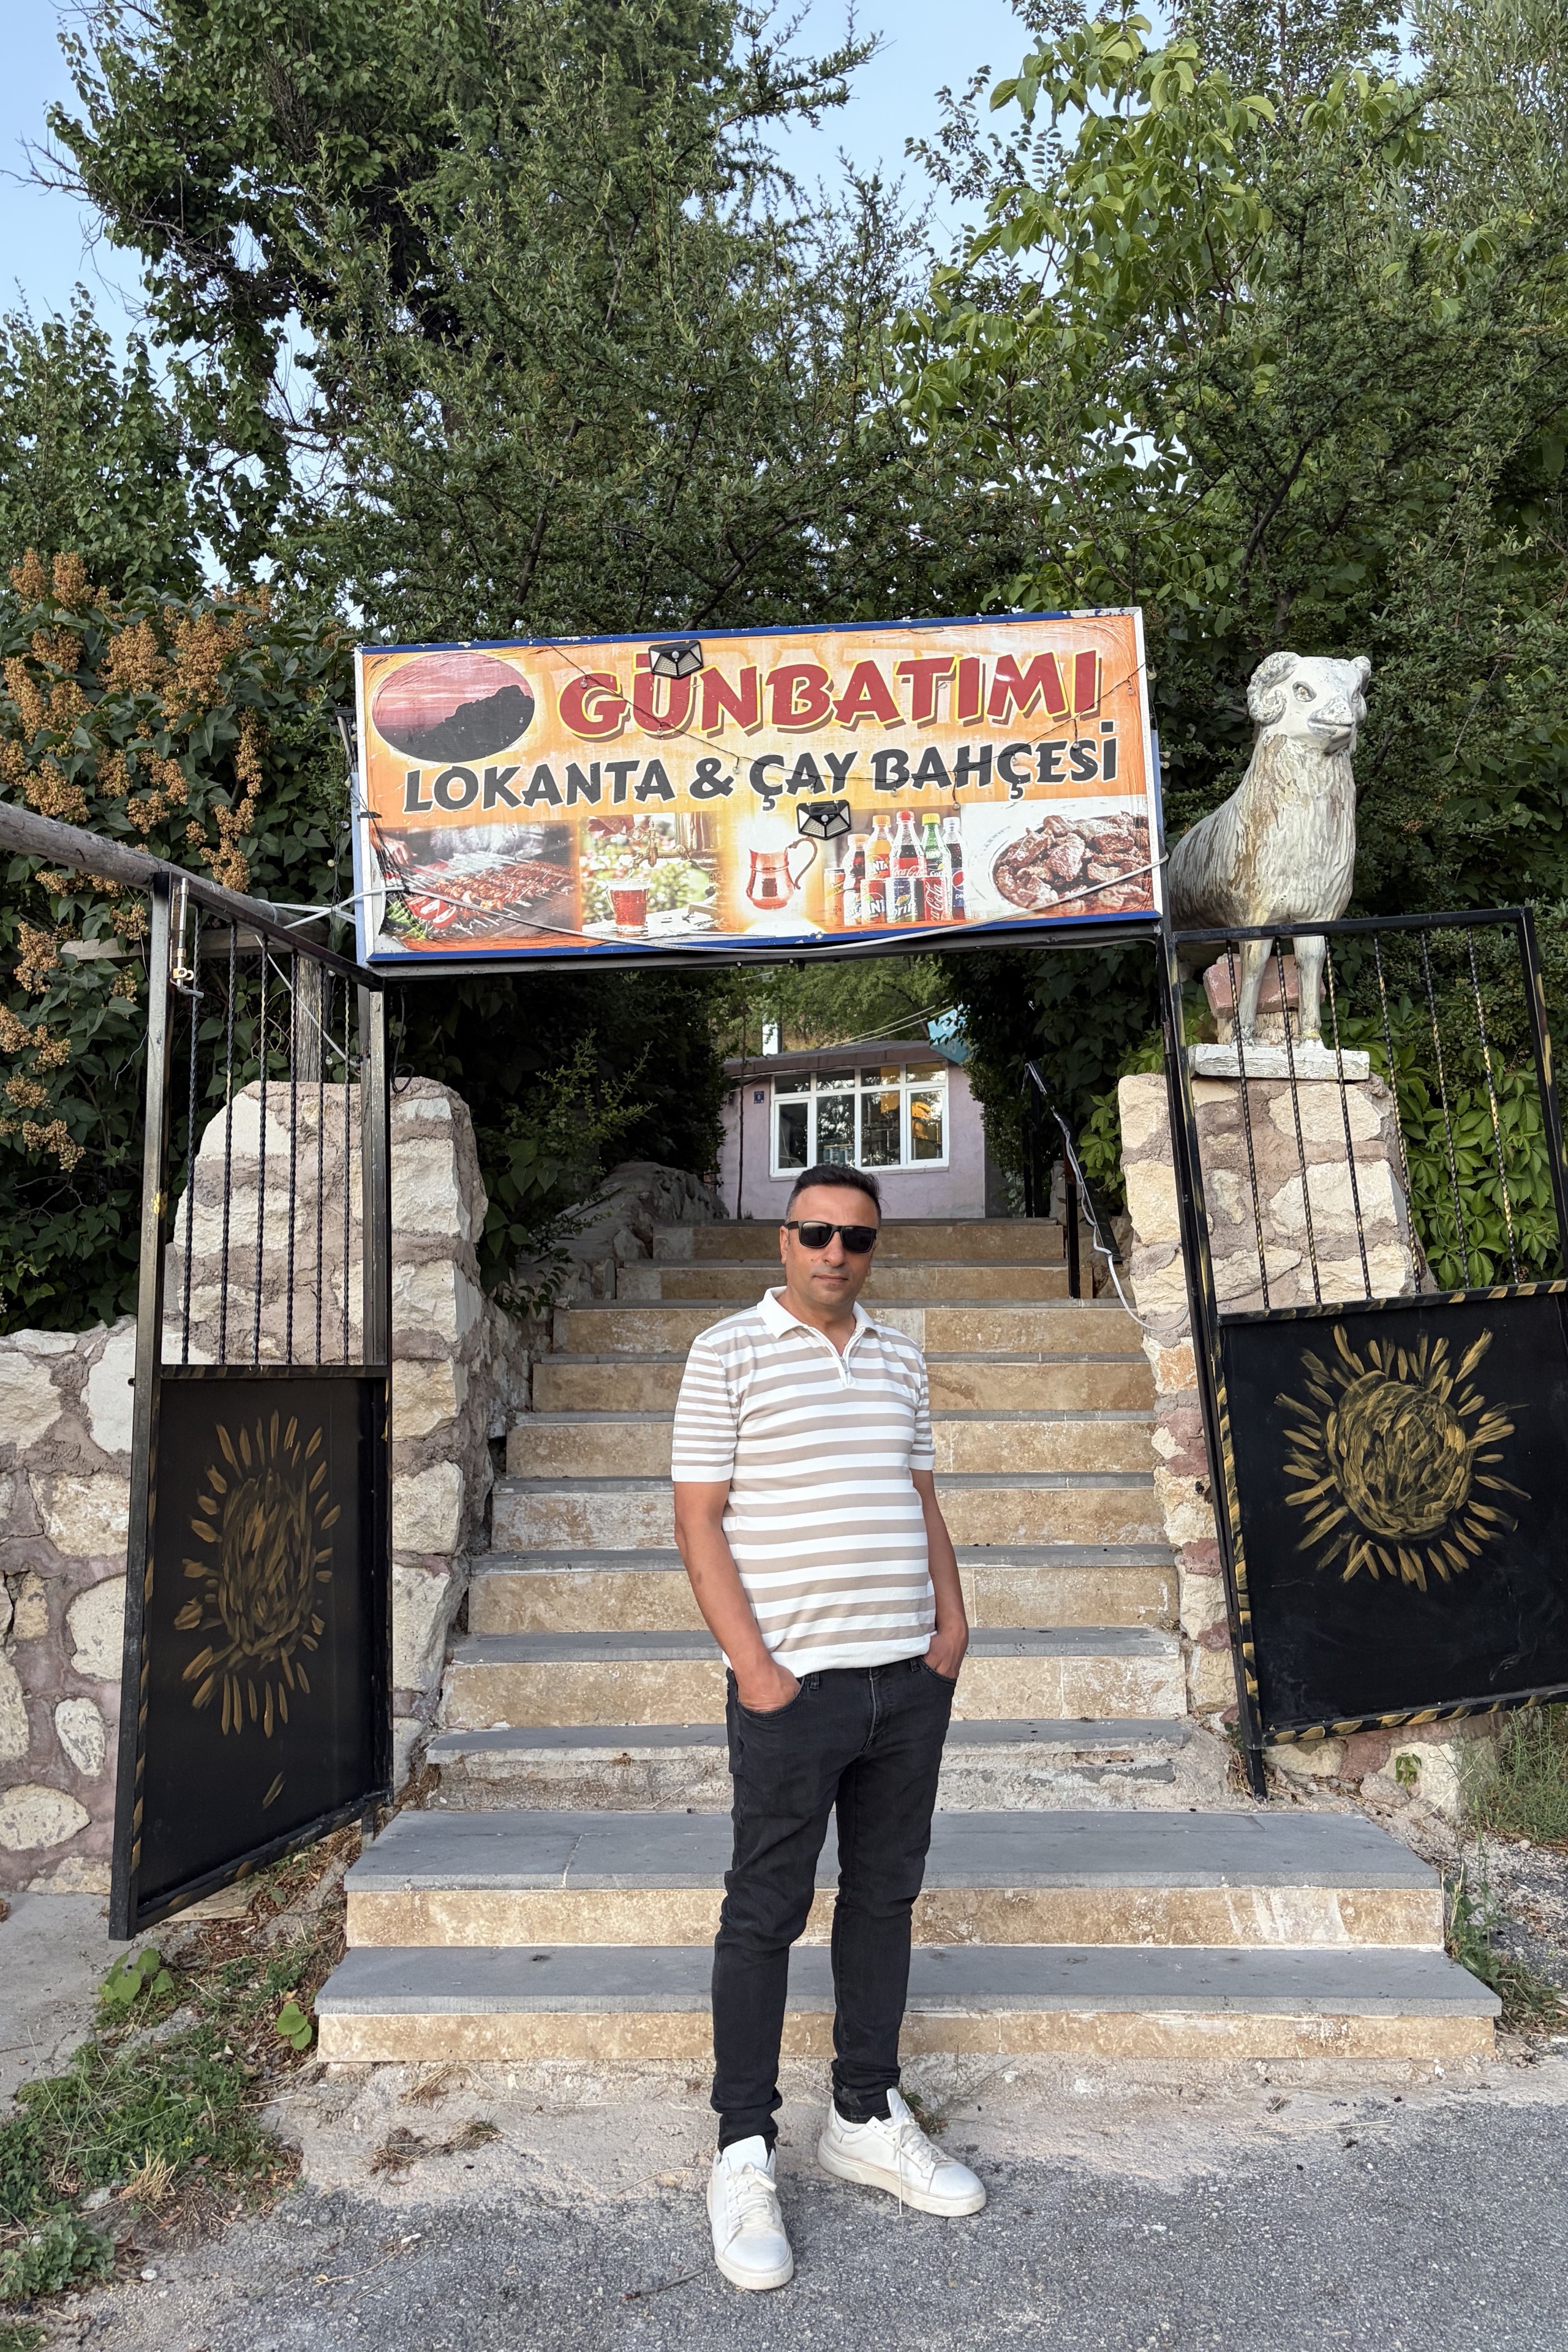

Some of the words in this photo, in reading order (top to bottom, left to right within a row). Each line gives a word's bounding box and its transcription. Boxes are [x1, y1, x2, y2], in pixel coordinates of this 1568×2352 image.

[557, 649, 1099, 739] GÜNBATIMI
[404, 758, 676, 813] LOKANTA
[689, 757, 735, 800] &
[749, 751, 859, 812] ÇAY
[871, 720, 1117, 798] BAHÇESİ
